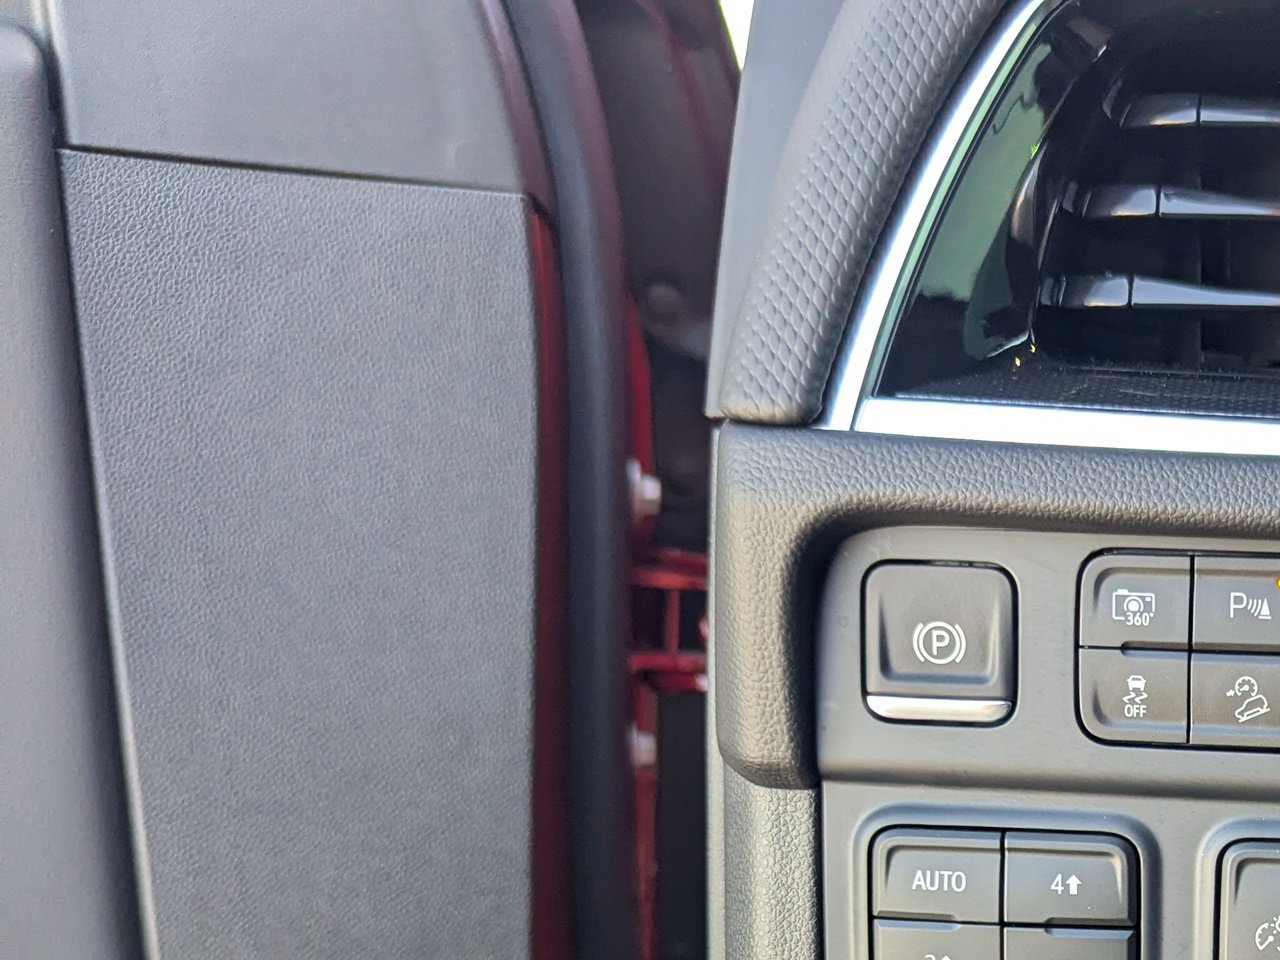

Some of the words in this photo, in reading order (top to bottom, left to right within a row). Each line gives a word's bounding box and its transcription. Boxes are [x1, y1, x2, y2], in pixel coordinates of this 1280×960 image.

[931, 635, 949, 656] P
[1124, 703, 1148, 718] OFF
[911, 870, 967, 893] AUTO
[1050, 873, 1064, 894] 4
